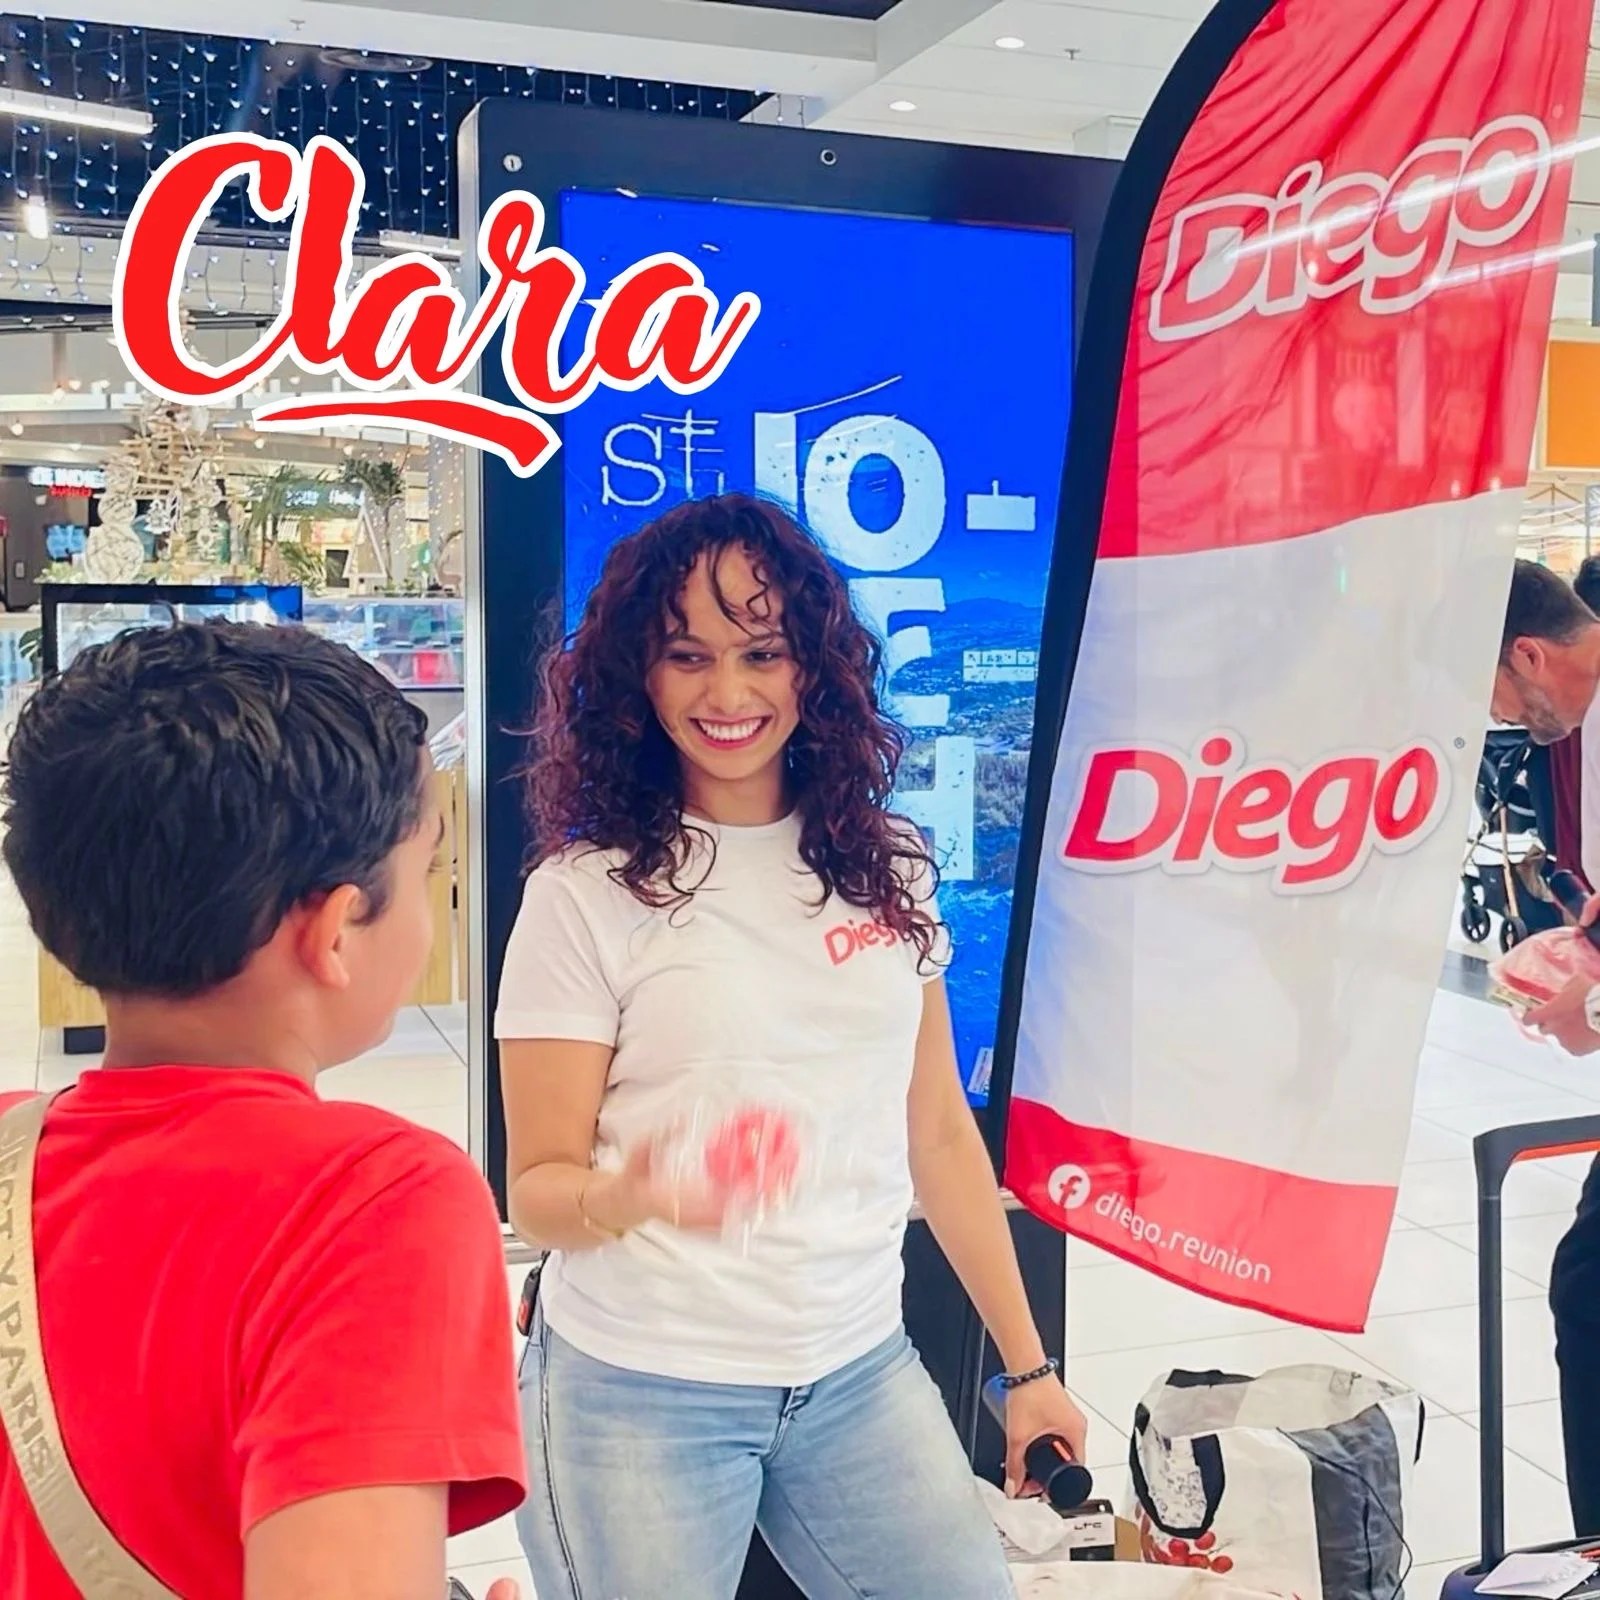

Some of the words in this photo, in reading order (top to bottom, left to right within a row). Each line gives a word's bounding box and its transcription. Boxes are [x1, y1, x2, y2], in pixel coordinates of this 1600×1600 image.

[1152, 118, 1545, 336] Diego
[1062, 736, 1440, 885] Diego
[824, 918, 898, 966] Dieg
[1095, 1192, 1271, 1284] diego.reunion
[0, 1300, 49, 1480] PARIS
